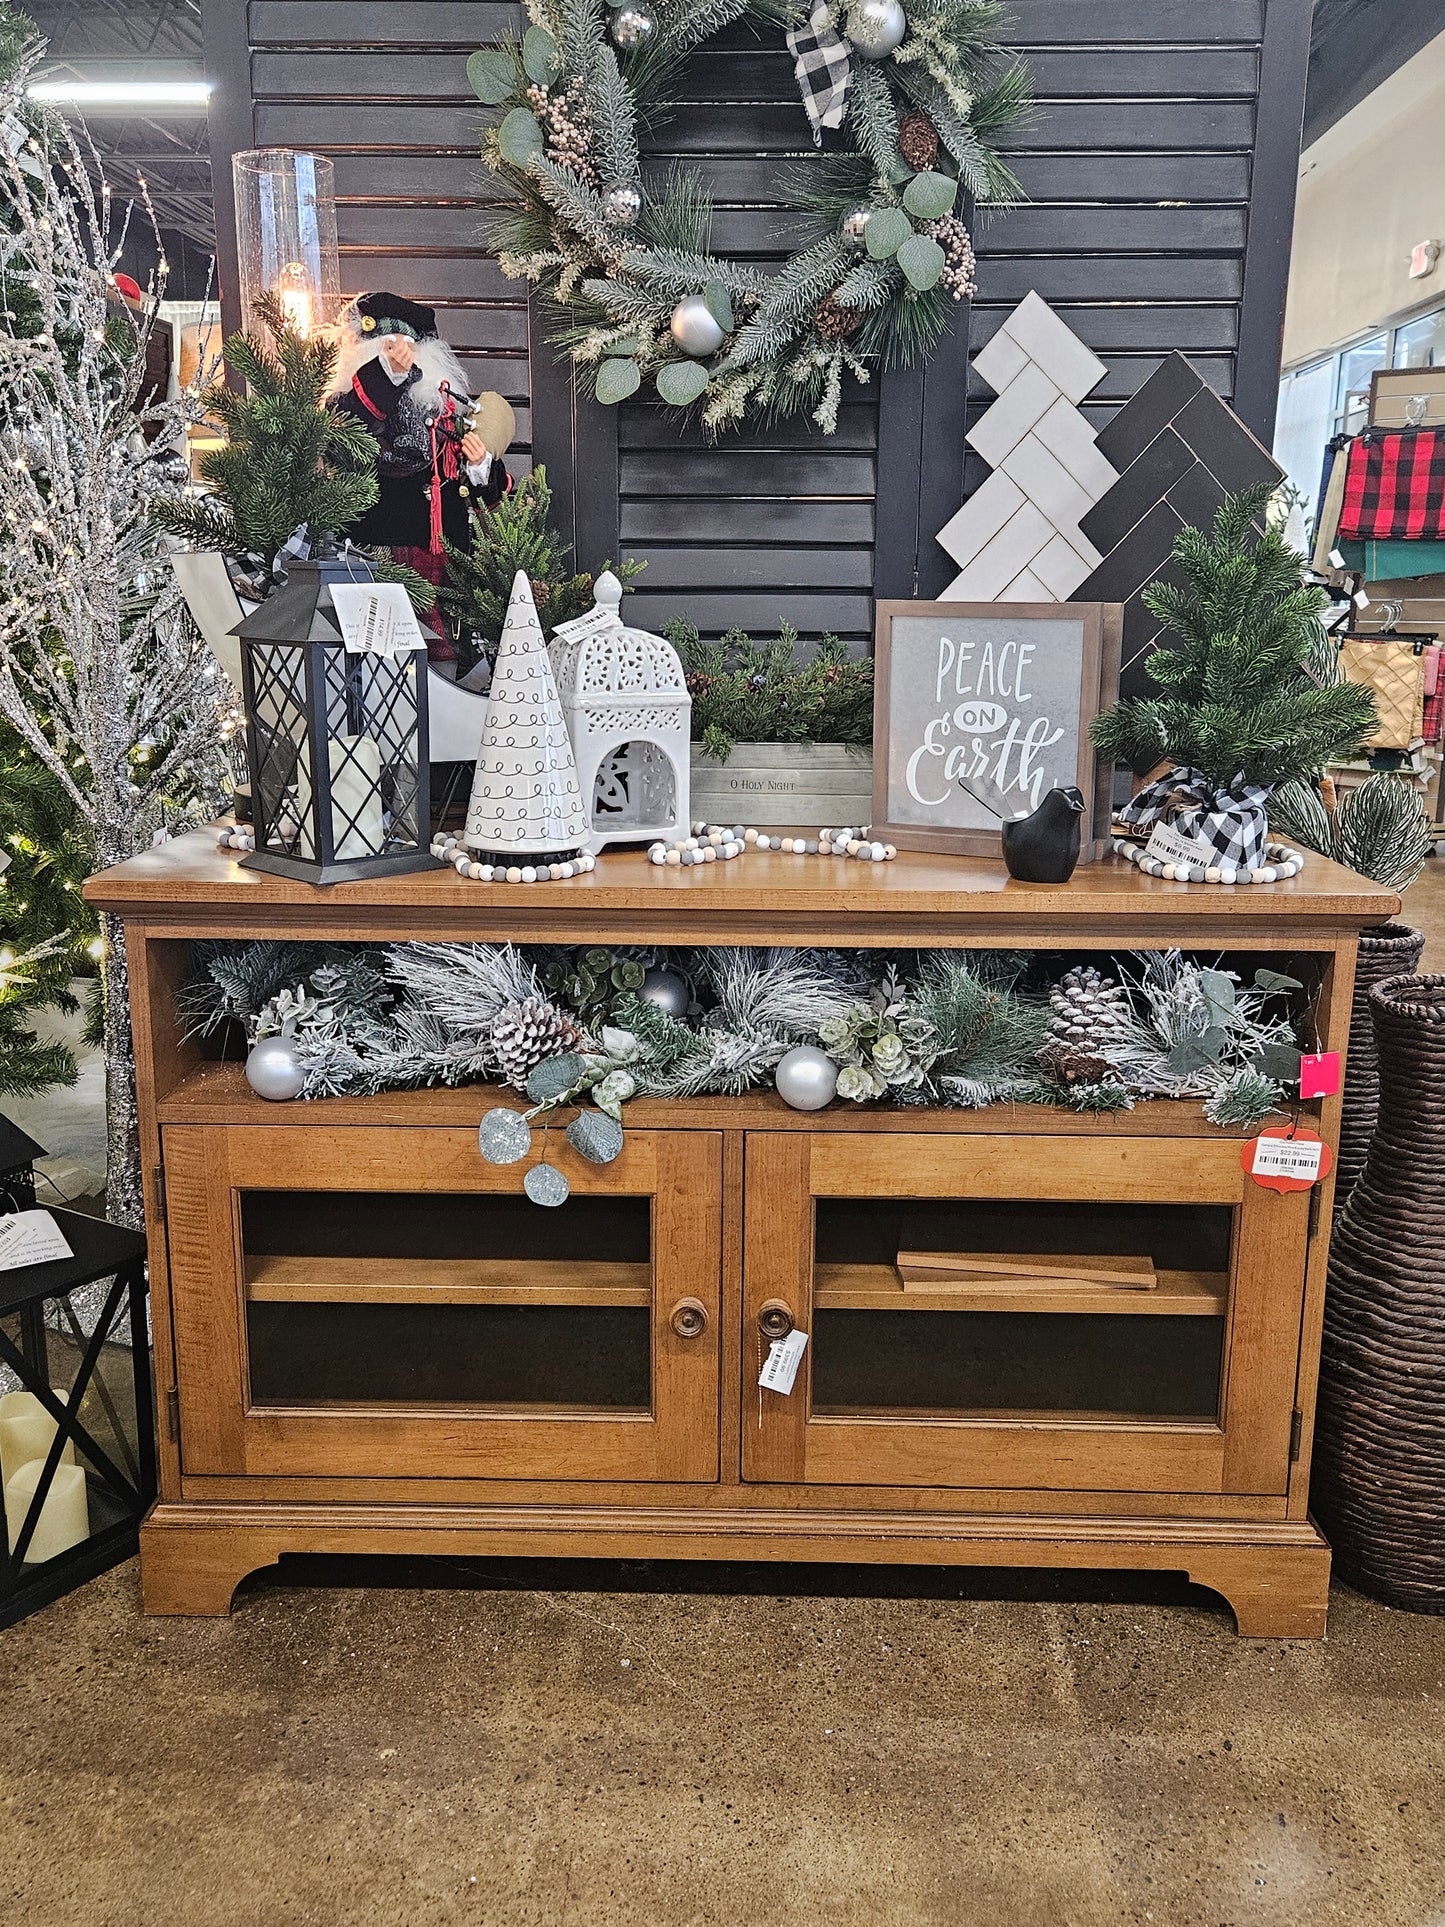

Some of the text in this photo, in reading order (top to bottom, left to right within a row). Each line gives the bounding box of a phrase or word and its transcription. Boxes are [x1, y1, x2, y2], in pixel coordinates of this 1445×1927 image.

[936, 637, 1037, 703] PEACE
[963, 707, 996, 727] ON
[906, 711, 1065, 810] Earth
[730, 779, 738, 790] O
[1280, 1149, 1301, 1157] $22.99
